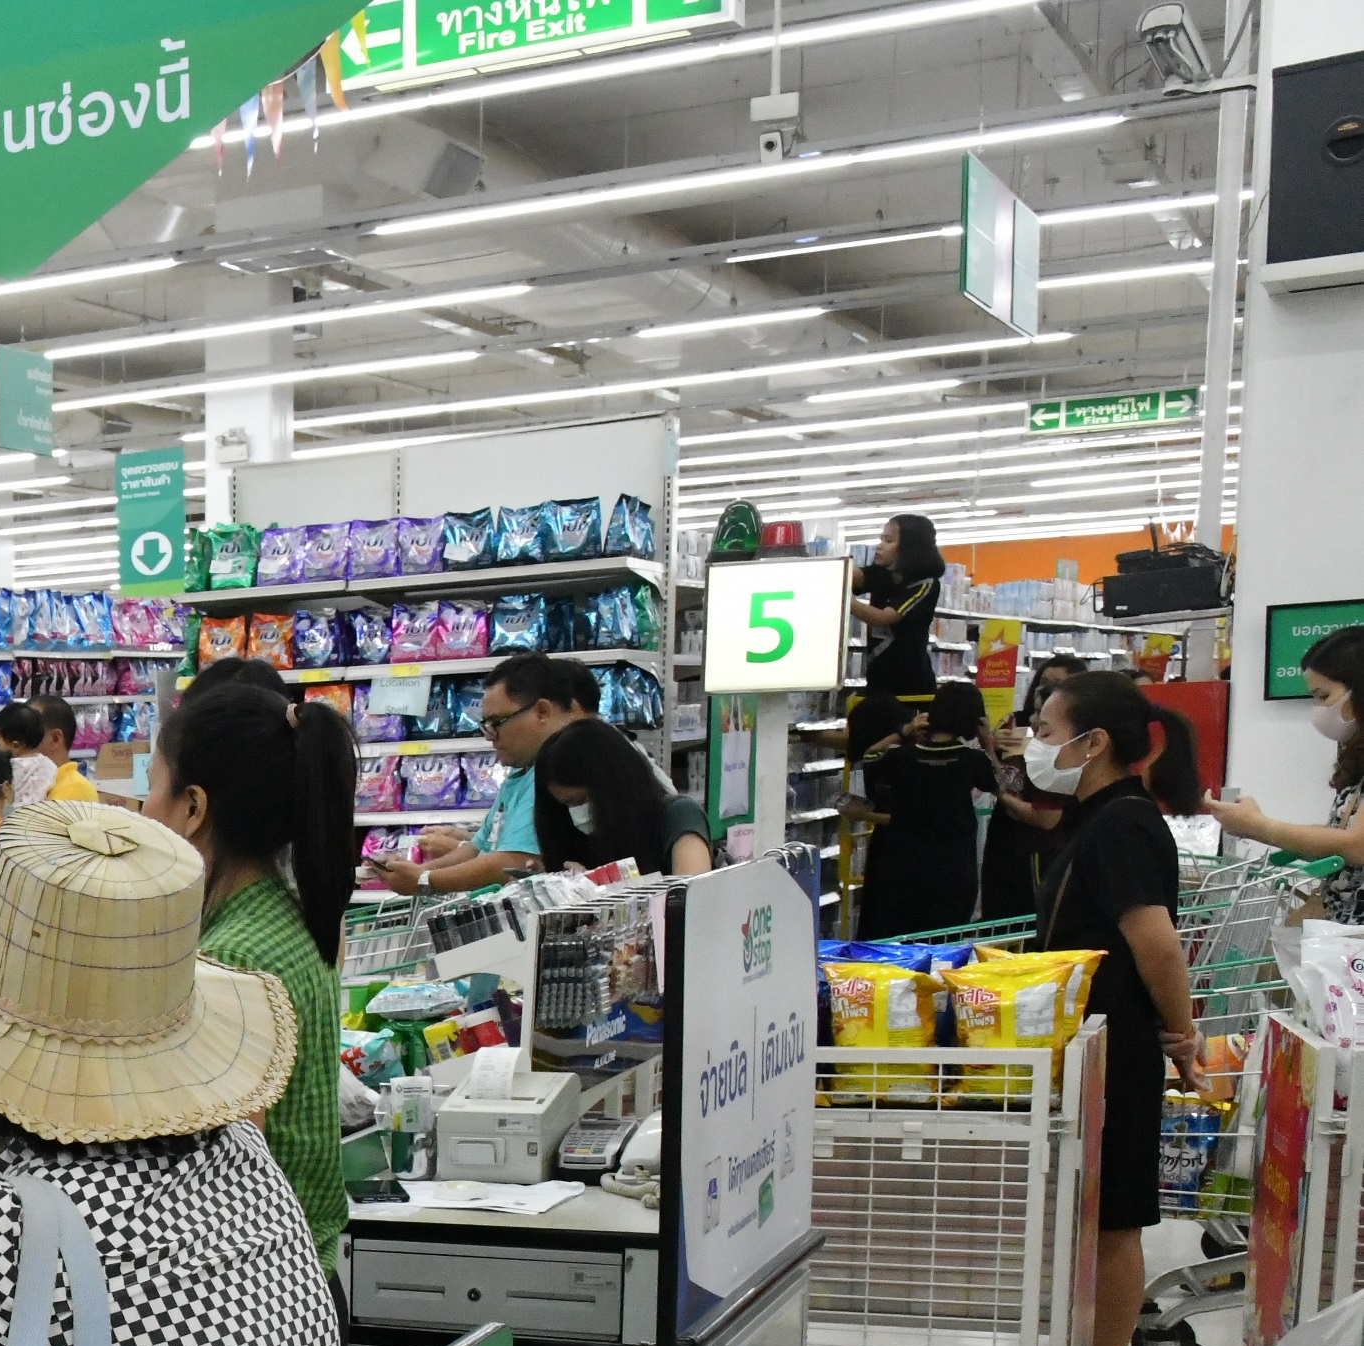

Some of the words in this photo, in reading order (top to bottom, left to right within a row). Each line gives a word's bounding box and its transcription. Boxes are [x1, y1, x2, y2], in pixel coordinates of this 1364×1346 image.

[458, 29, 517, 54] Fire
[526, 11, 587, 42] Exit
[1083, 416, 1109, 425] Fire
[1113, 413, 1139, 423] Exit
[745, 590, 795, 663] 5
[752, 905, 772, 938] one
[752, 934, 772, 973] stop
[585, 1012, 626, 1048] Panasonic
[760, 1012, 805, 1085] เติมเงิน
[699, 1040, 748, 1119] จ่ายบิล
